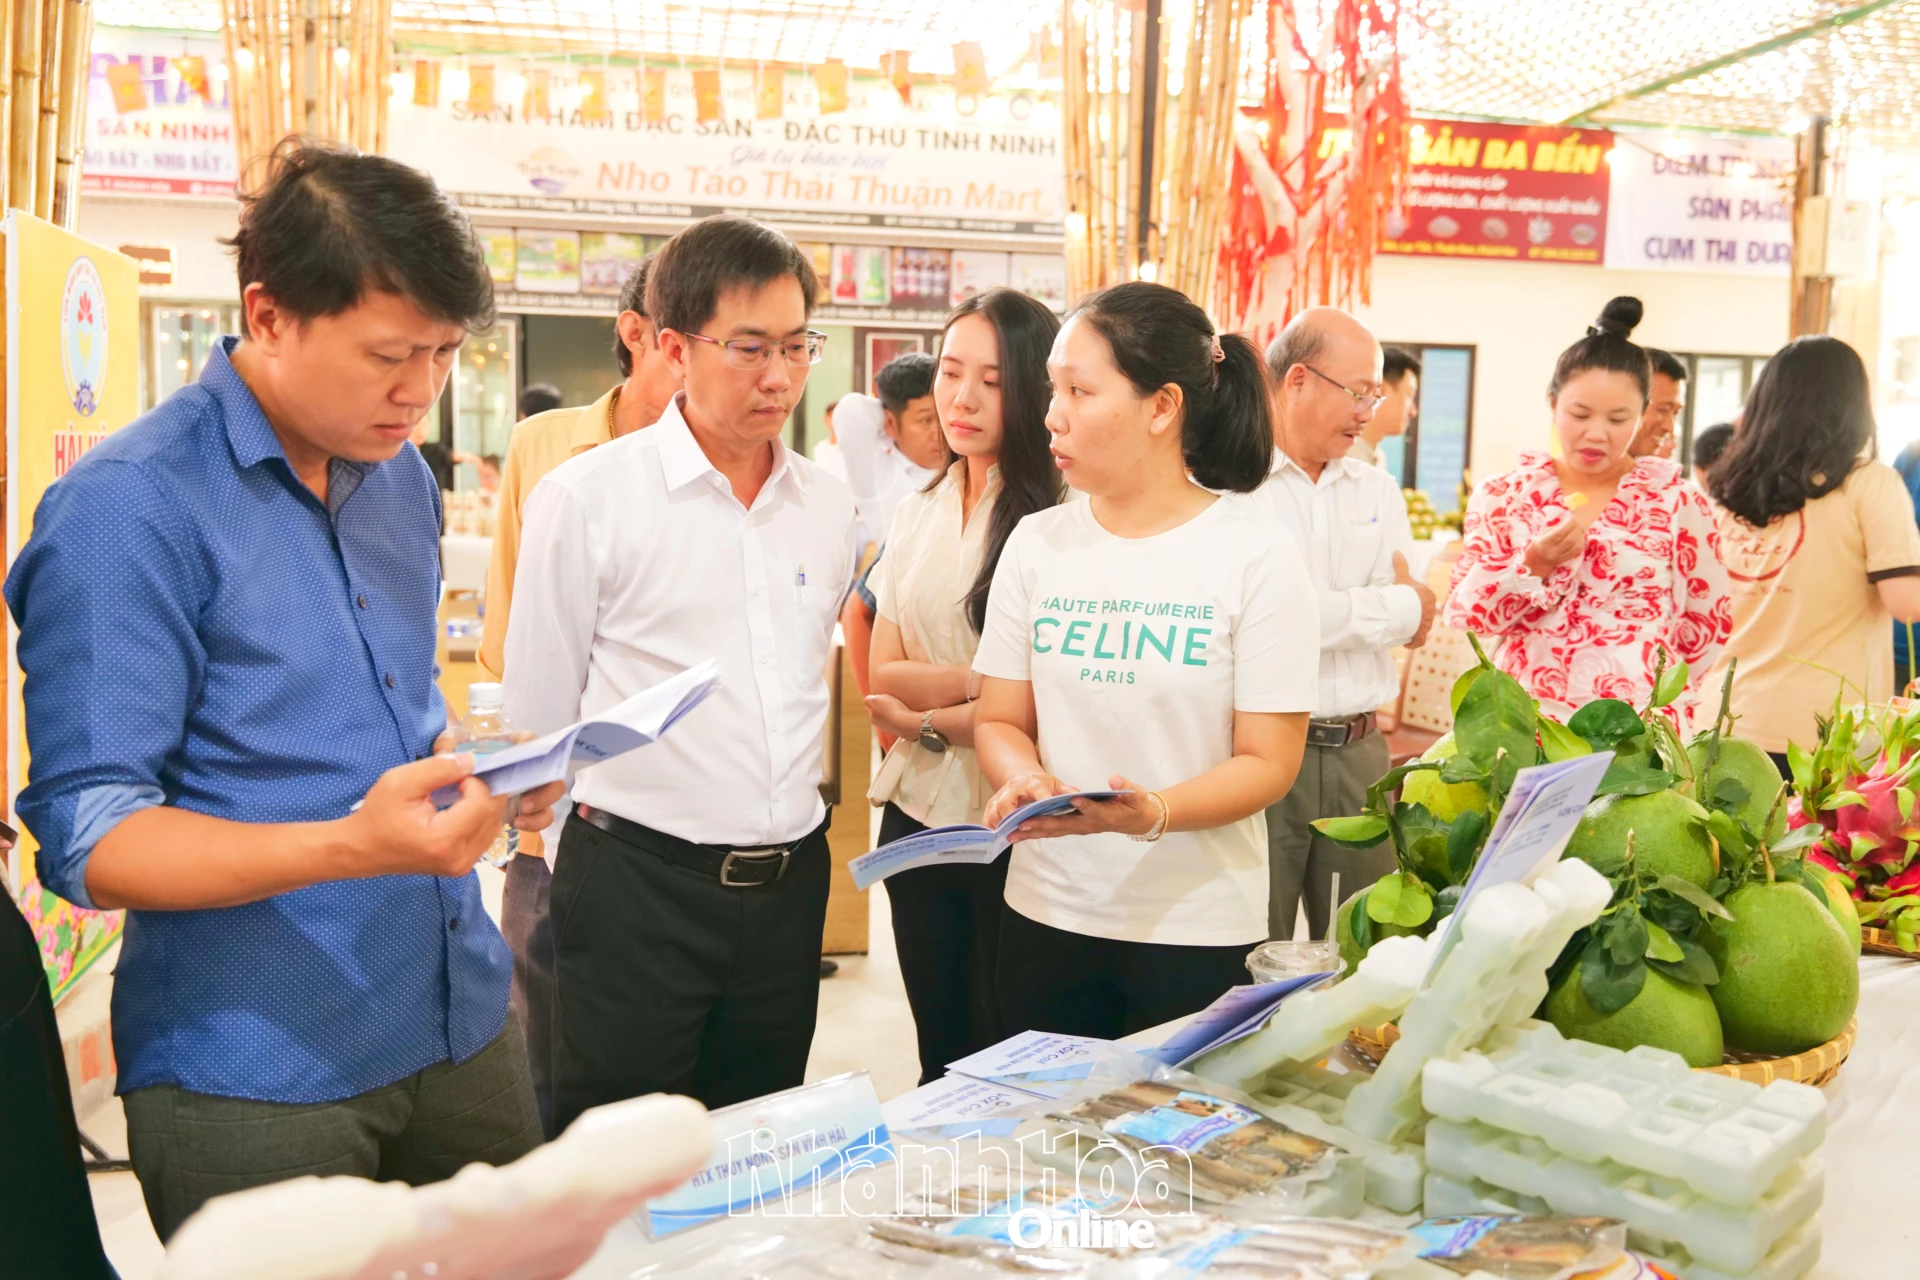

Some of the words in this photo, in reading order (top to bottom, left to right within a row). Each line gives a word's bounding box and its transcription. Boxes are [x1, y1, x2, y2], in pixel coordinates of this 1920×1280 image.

[161, 122, 231, 144] NINH
[989, 133, 1057, 156] NINH
[1481, 138, 1528, 171] BA
[596, 161, 671, 194] Nho
[762, 169, 835, 201] Thái
[849, 174, 955, 213] Thuận
[963, 182, 1043, 213] Mart
[1704, 239, 1737, 262] THI
[1039, 597, 1098, 614] HAUTE
[1102, 599, 1215, 620] PARFUMERIE
[1032, 617, 1213, 667] CELINE
[1080, 668, 1136, 685] PARIS
